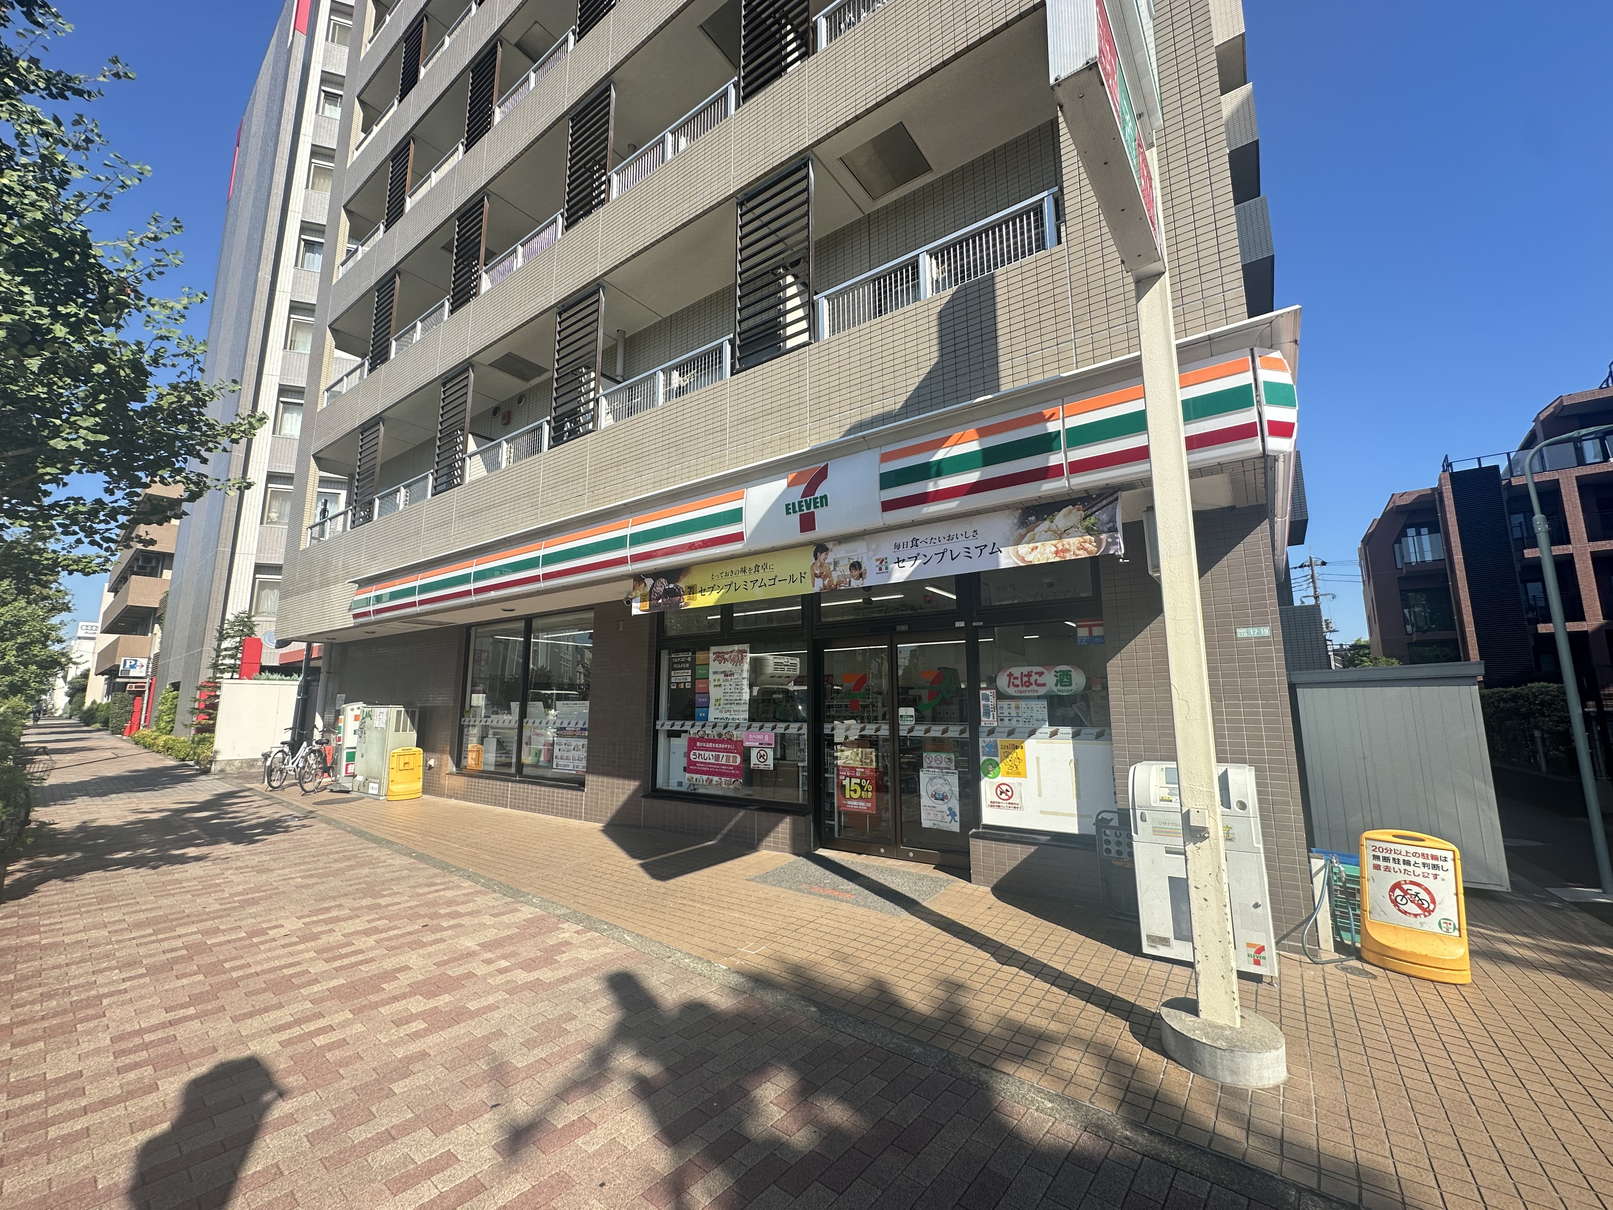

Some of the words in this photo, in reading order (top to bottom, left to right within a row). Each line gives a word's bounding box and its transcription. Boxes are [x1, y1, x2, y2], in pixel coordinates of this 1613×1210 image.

[893, 528, 980, 551] 毎日食べたいおいしさ
[894, 541, 1003, 569] セブンプレミアム
[698, 571, 807, 597] セブンプレミアムゴールド
[1007, 671, 1047, 689] たばこ
[1054, 669, 1073, 687] 酒
[1372, 845, 1448, 862] 20分以上の駐輪は
[1372, 854, 1449, 872] 無断駐輪と判断し
[1372, 864, 1440, 880] 撤去いたします
